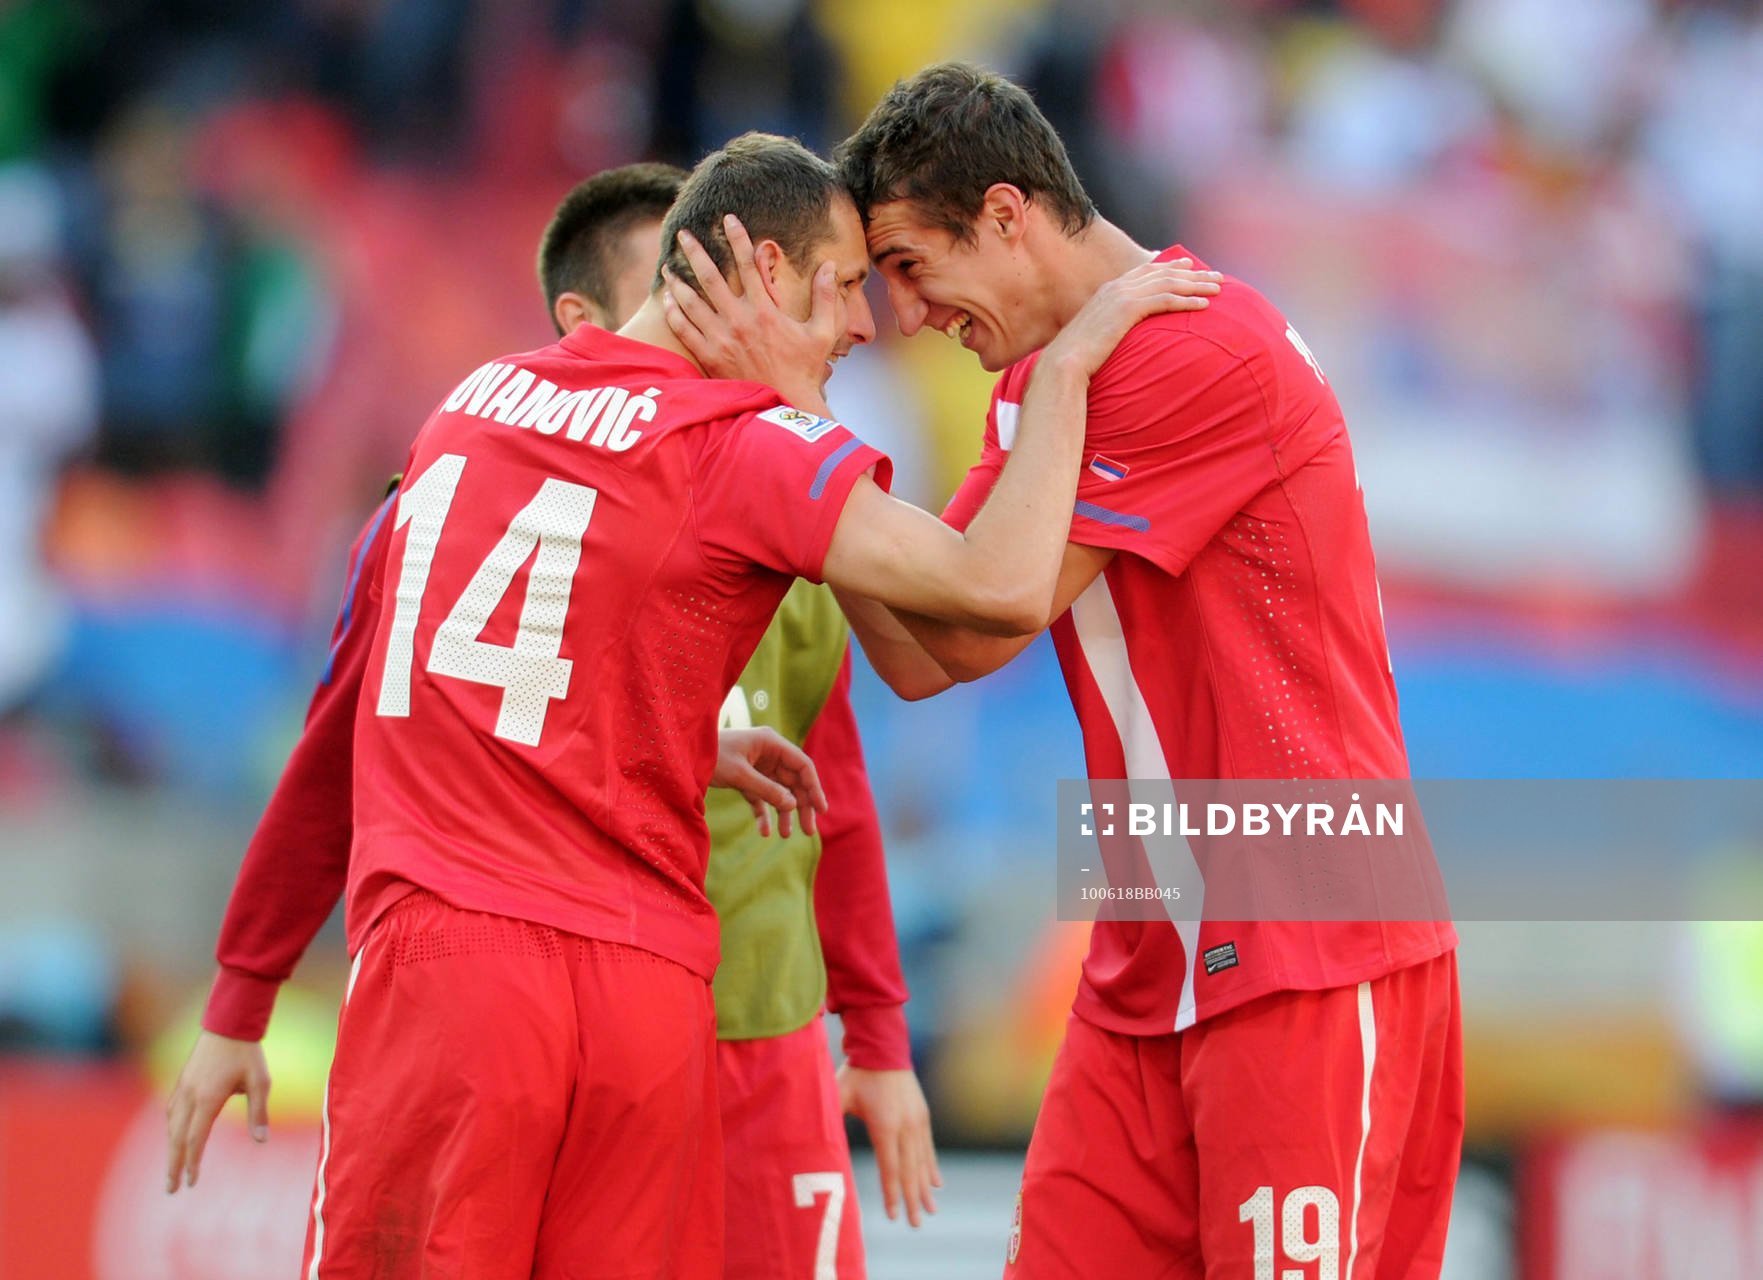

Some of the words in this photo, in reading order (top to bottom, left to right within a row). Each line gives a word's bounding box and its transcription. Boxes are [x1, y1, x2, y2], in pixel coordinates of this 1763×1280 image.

[439, 362, 662, 452] OVANOVIĆ
[376, 453, 598, 747] 14
[792, 1172, 845, 1280] 7
[1239, 1186, 1340, 1280] 19
